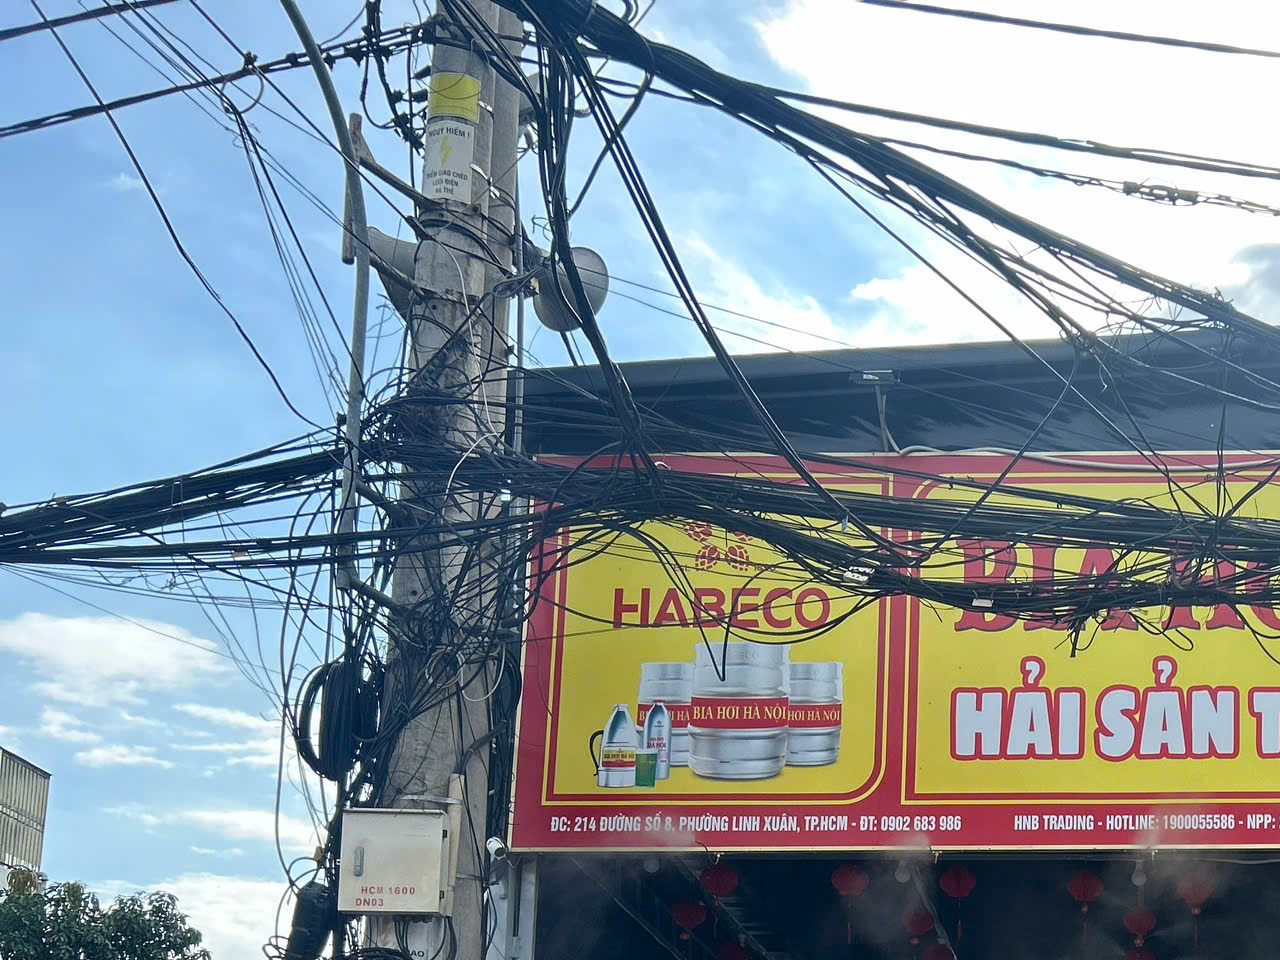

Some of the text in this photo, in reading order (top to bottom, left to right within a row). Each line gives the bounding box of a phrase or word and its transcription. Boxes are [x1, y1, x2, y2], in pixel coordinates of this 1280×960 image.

[613, 587, 831, 629] HABECO
[693, 706, 713, 720] BIA
[743, 703, 760, 719] HÀ
[764, 703, 787, 723] NỘI
[950, 656, 1086, 762] HẢI
[1094, 656, 1240, 762] SẢN
[551, 816, 570, 832] ĐC:
[574, 816, 596, 832] 214
[600, 812, 641, 832] ĐƯỜNG
[644, 810, 662, 832] SỐ
[679, 812, 728, 832] PHƯỜNG
[732, 816, 760, 832] LINH
[763, 813, 800, 833] XUÂN,
[804, 815, 848, 831] TP.HCM
[860, 815, 878, 831] ĐT:
[881, 815, 910, 831] 0902
[914, 815, 936, 831] 683
[939, 815, 962, 831] 986
[1014, 815, 1039, 831] HNB
[1043, 815, 1094, 830] TRADING
[1106, 815, 1159, 830] HOTLINE:
[1163, 814, 1235, 830] 1900055586
[1247, 814, 1275, 829] NPP:
[361, 886, 415, 895] HCM 1600
[355, 898, 384, 907] DN03
